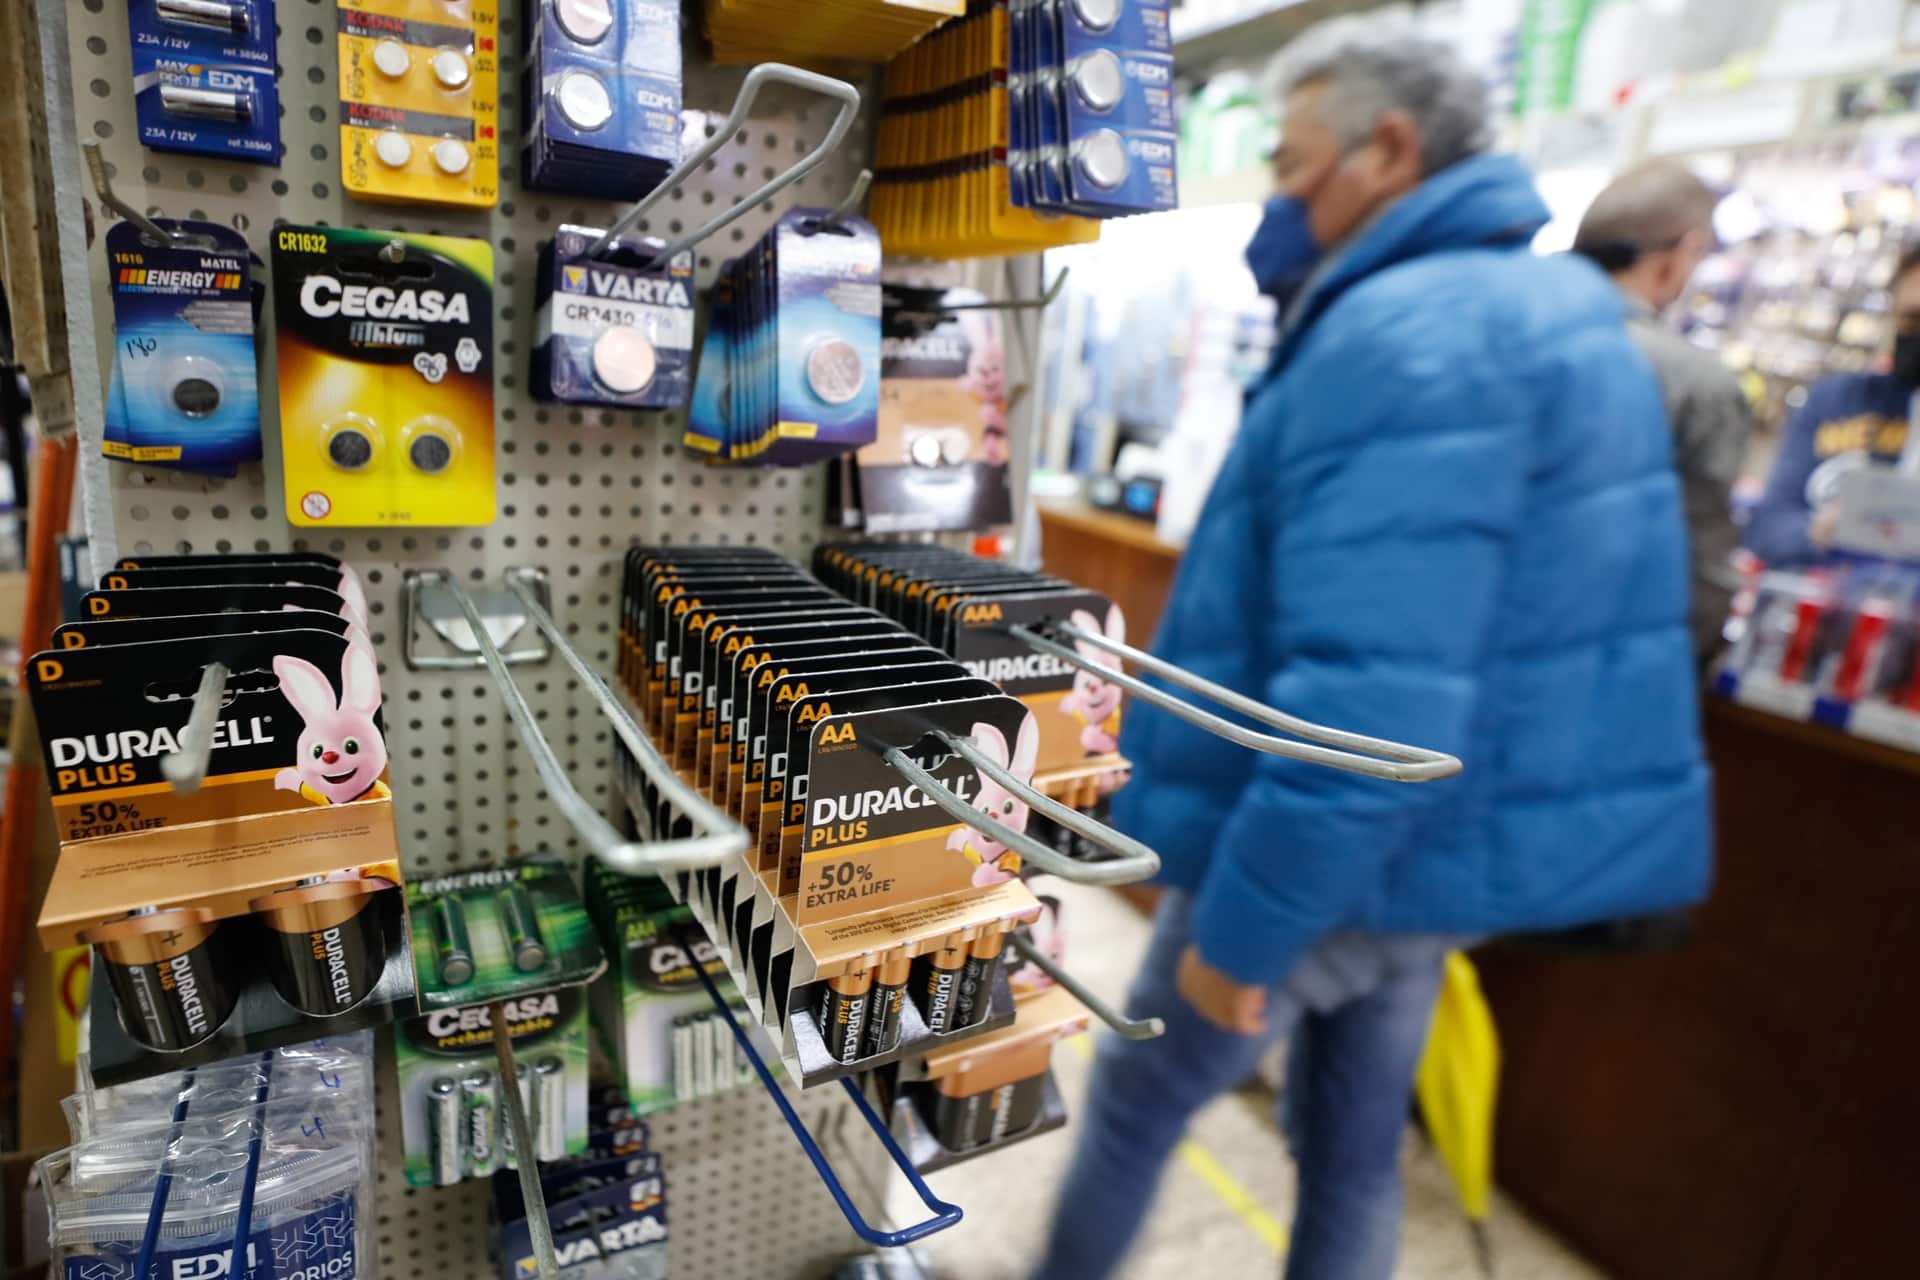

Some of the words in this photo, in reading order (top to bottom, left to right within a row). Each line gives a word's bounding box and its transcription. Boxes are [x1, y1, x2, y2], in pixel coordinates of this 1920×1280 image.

[347, 10, 405, 32] KODAK
[347, 25, 367, 35] MAX
[137, 33, 160, 44] 23A
[171, 37, 190, 49] 12V
[155, 59, 188, 72] MAX
[207, 69, 254, 92] EDM
[349, 105, 405, 123] KODAK
[350, 117, 369, 127] MAX
[144, 128, 167, 138] 23A
[177, 131, 197, 142] 12V
[278, 231, 327, 253] CR1632
[114, 252, 144, 264] 1616
[200, 258, 241, 270] MATEL
[146, 270, 216, 288] ENERGY
[591, 270, 690, 306] VARTA
[300, 274, 470, 324] CEGASA
[109, 576, 128, 591] D
[90, 597, 111, 616] D
[963, 603, 1003, 623] AAA
[62, 631, 86, 650] D
[36, 659, 64, 682] D
[776, 682, 809, 703] AA
[797, 701, 832, 724] AA
[818, 722, 857, 745] AA
[56, 761, 137, 791] PLUS
[69, 800, 141, 828] +50%
[71, 823, 130, 841] EXTRA
[811, 821, 869, 848] PLUS
[807, 861, 874, 893] +50%
[806, 888, 857, 909] EXTRA
[311, 933, 326, 960] PLUS
[157, 962, 177, 991] PLUS
[322, 927, 352, 1004] DURACELL
[170, 955, 208, 1034] DURACELL
[838, 1000, 850, 1024] PLUS
[438, 1018, 553, 1048] rechareable
[555, 1216, 667, 1266] VARTA
